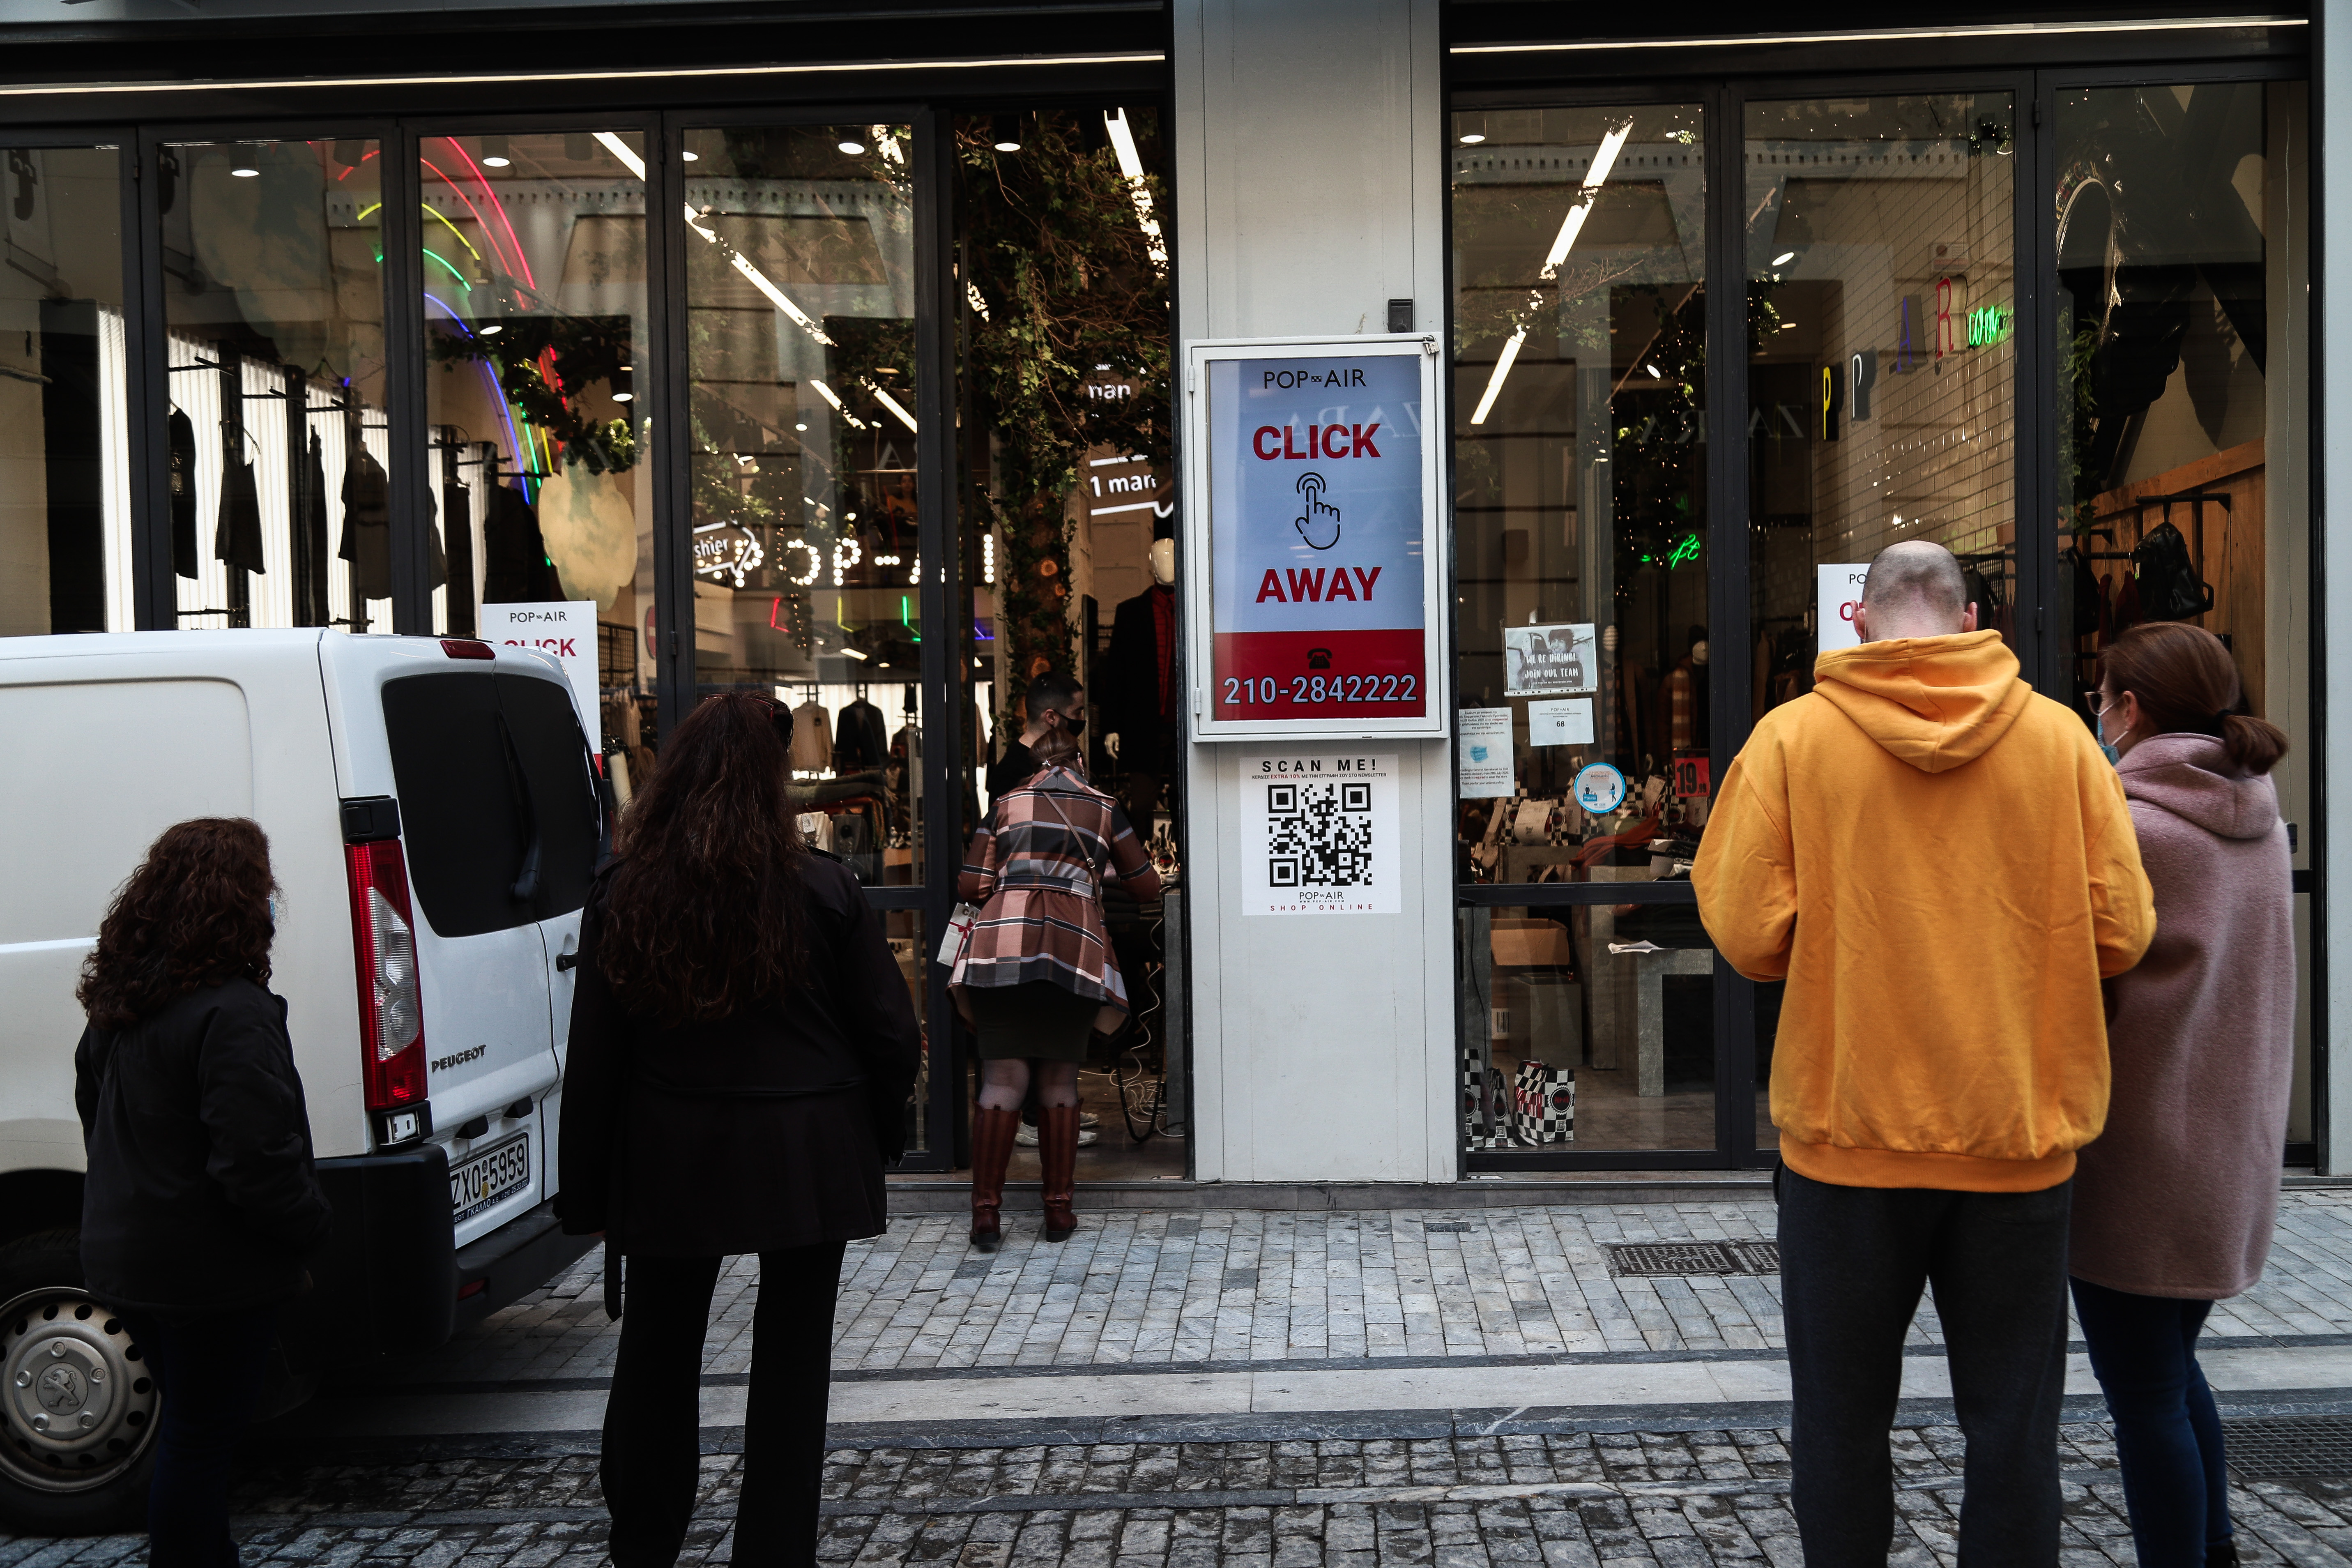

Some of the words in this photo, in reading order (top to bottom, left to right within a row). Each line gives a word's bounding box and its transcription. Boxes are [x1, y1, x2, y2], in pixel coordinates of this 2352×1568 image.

[1252, 423, 1382, 461] CLICK
[1090, 475, 1101, 497] 1
[694, 535, 729, 559] shier
[1255, 566, 1383, 604] AWAY
[1849, 574, 1867, 584] PO
[1544, 669, 1558, 678] OUR
[1560, 668, 1578, 677] TEAM
[1223, 674, 1418, 705] 210-2842222
[1262, 760, 1321, 773] SCAN
[1337, 759, 1376, 771] ME!
[431, 1044, 486, 1073] PEUGEOT
